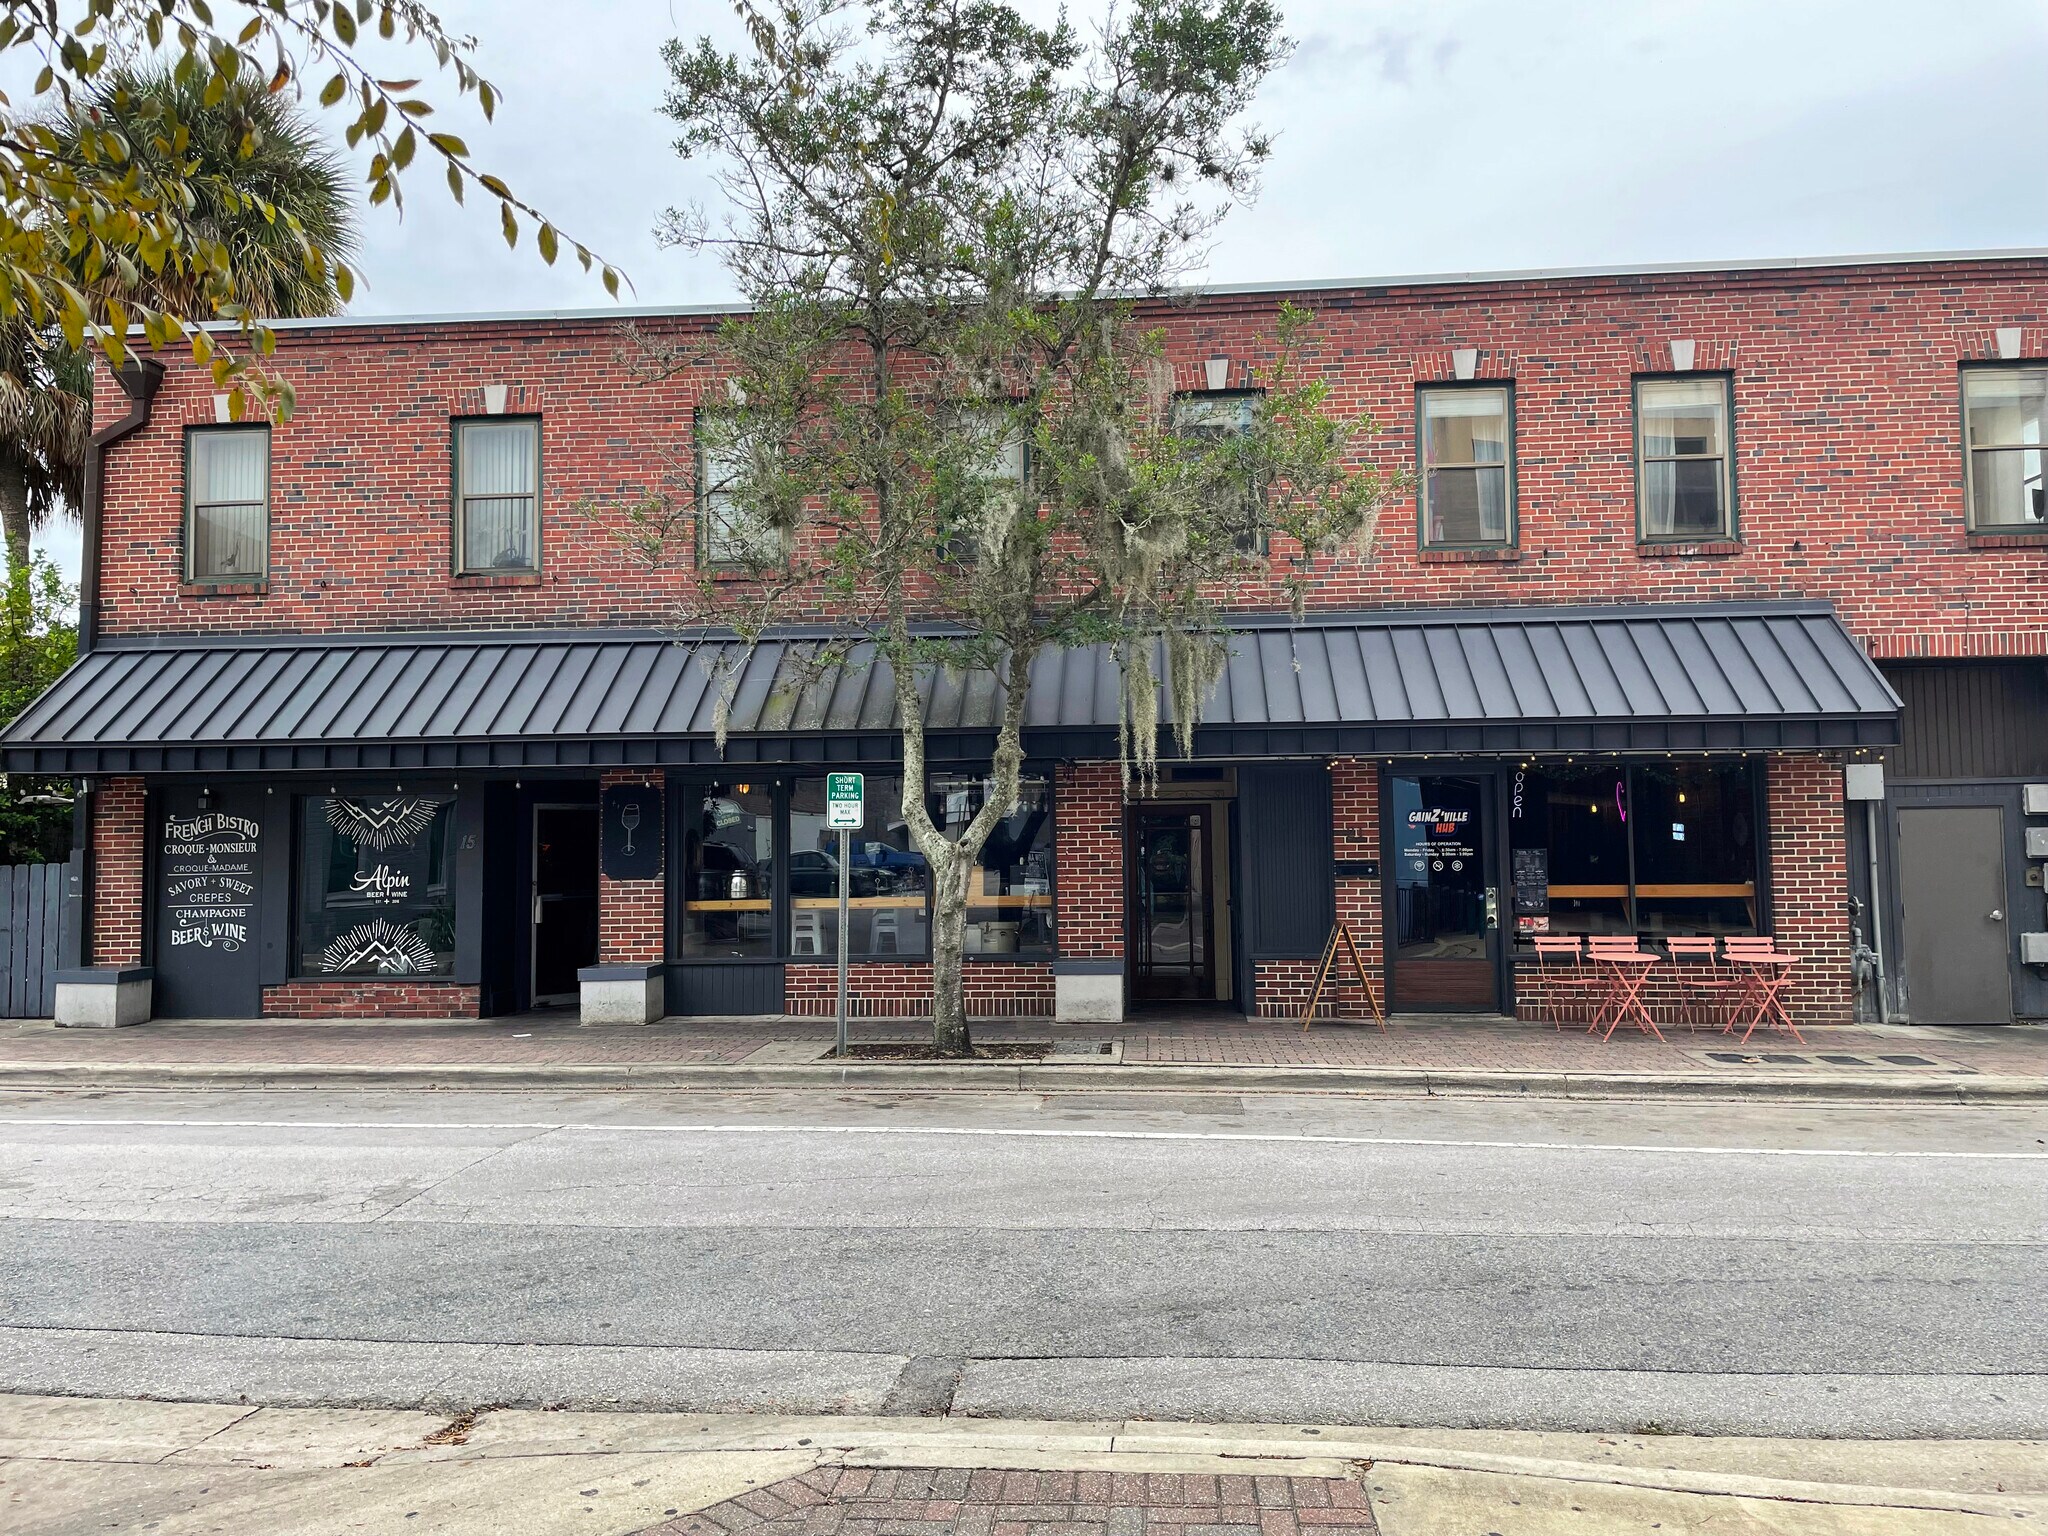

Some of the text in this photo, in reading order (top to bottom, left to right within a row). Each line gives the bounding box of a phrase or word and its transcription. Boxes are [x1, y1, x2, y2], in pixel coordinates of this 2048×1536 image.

[835, 776, 856, 784] SHORT
[837, 784, 854, 792] TERM
[1512, 771, 1525, 818] open
[164, 813, 259, 841] FRENCH BISTRO
[716, 815, 740, 827] CLOSED
[1435, 822, 1456, 833] HUB
[460, 834, 477, 850] 15
[164, 842, 257, 856] CROQUE-MONSIEUR
[207, 854, 217, 864] &
[173, 863, 249, 873] CROQUE-MADAME
[349, 863, 411, 897] Alpin
[167, 876, 208, 897] SAVORY
[219, 876, 254, 896] SWEET
[189, 892, 232, 903] CREPES
[175, 908, 247, 919] CHAMPAGNE
[171, 927, 213, 948] BEER
[211, 922, 247, 943] WINE
